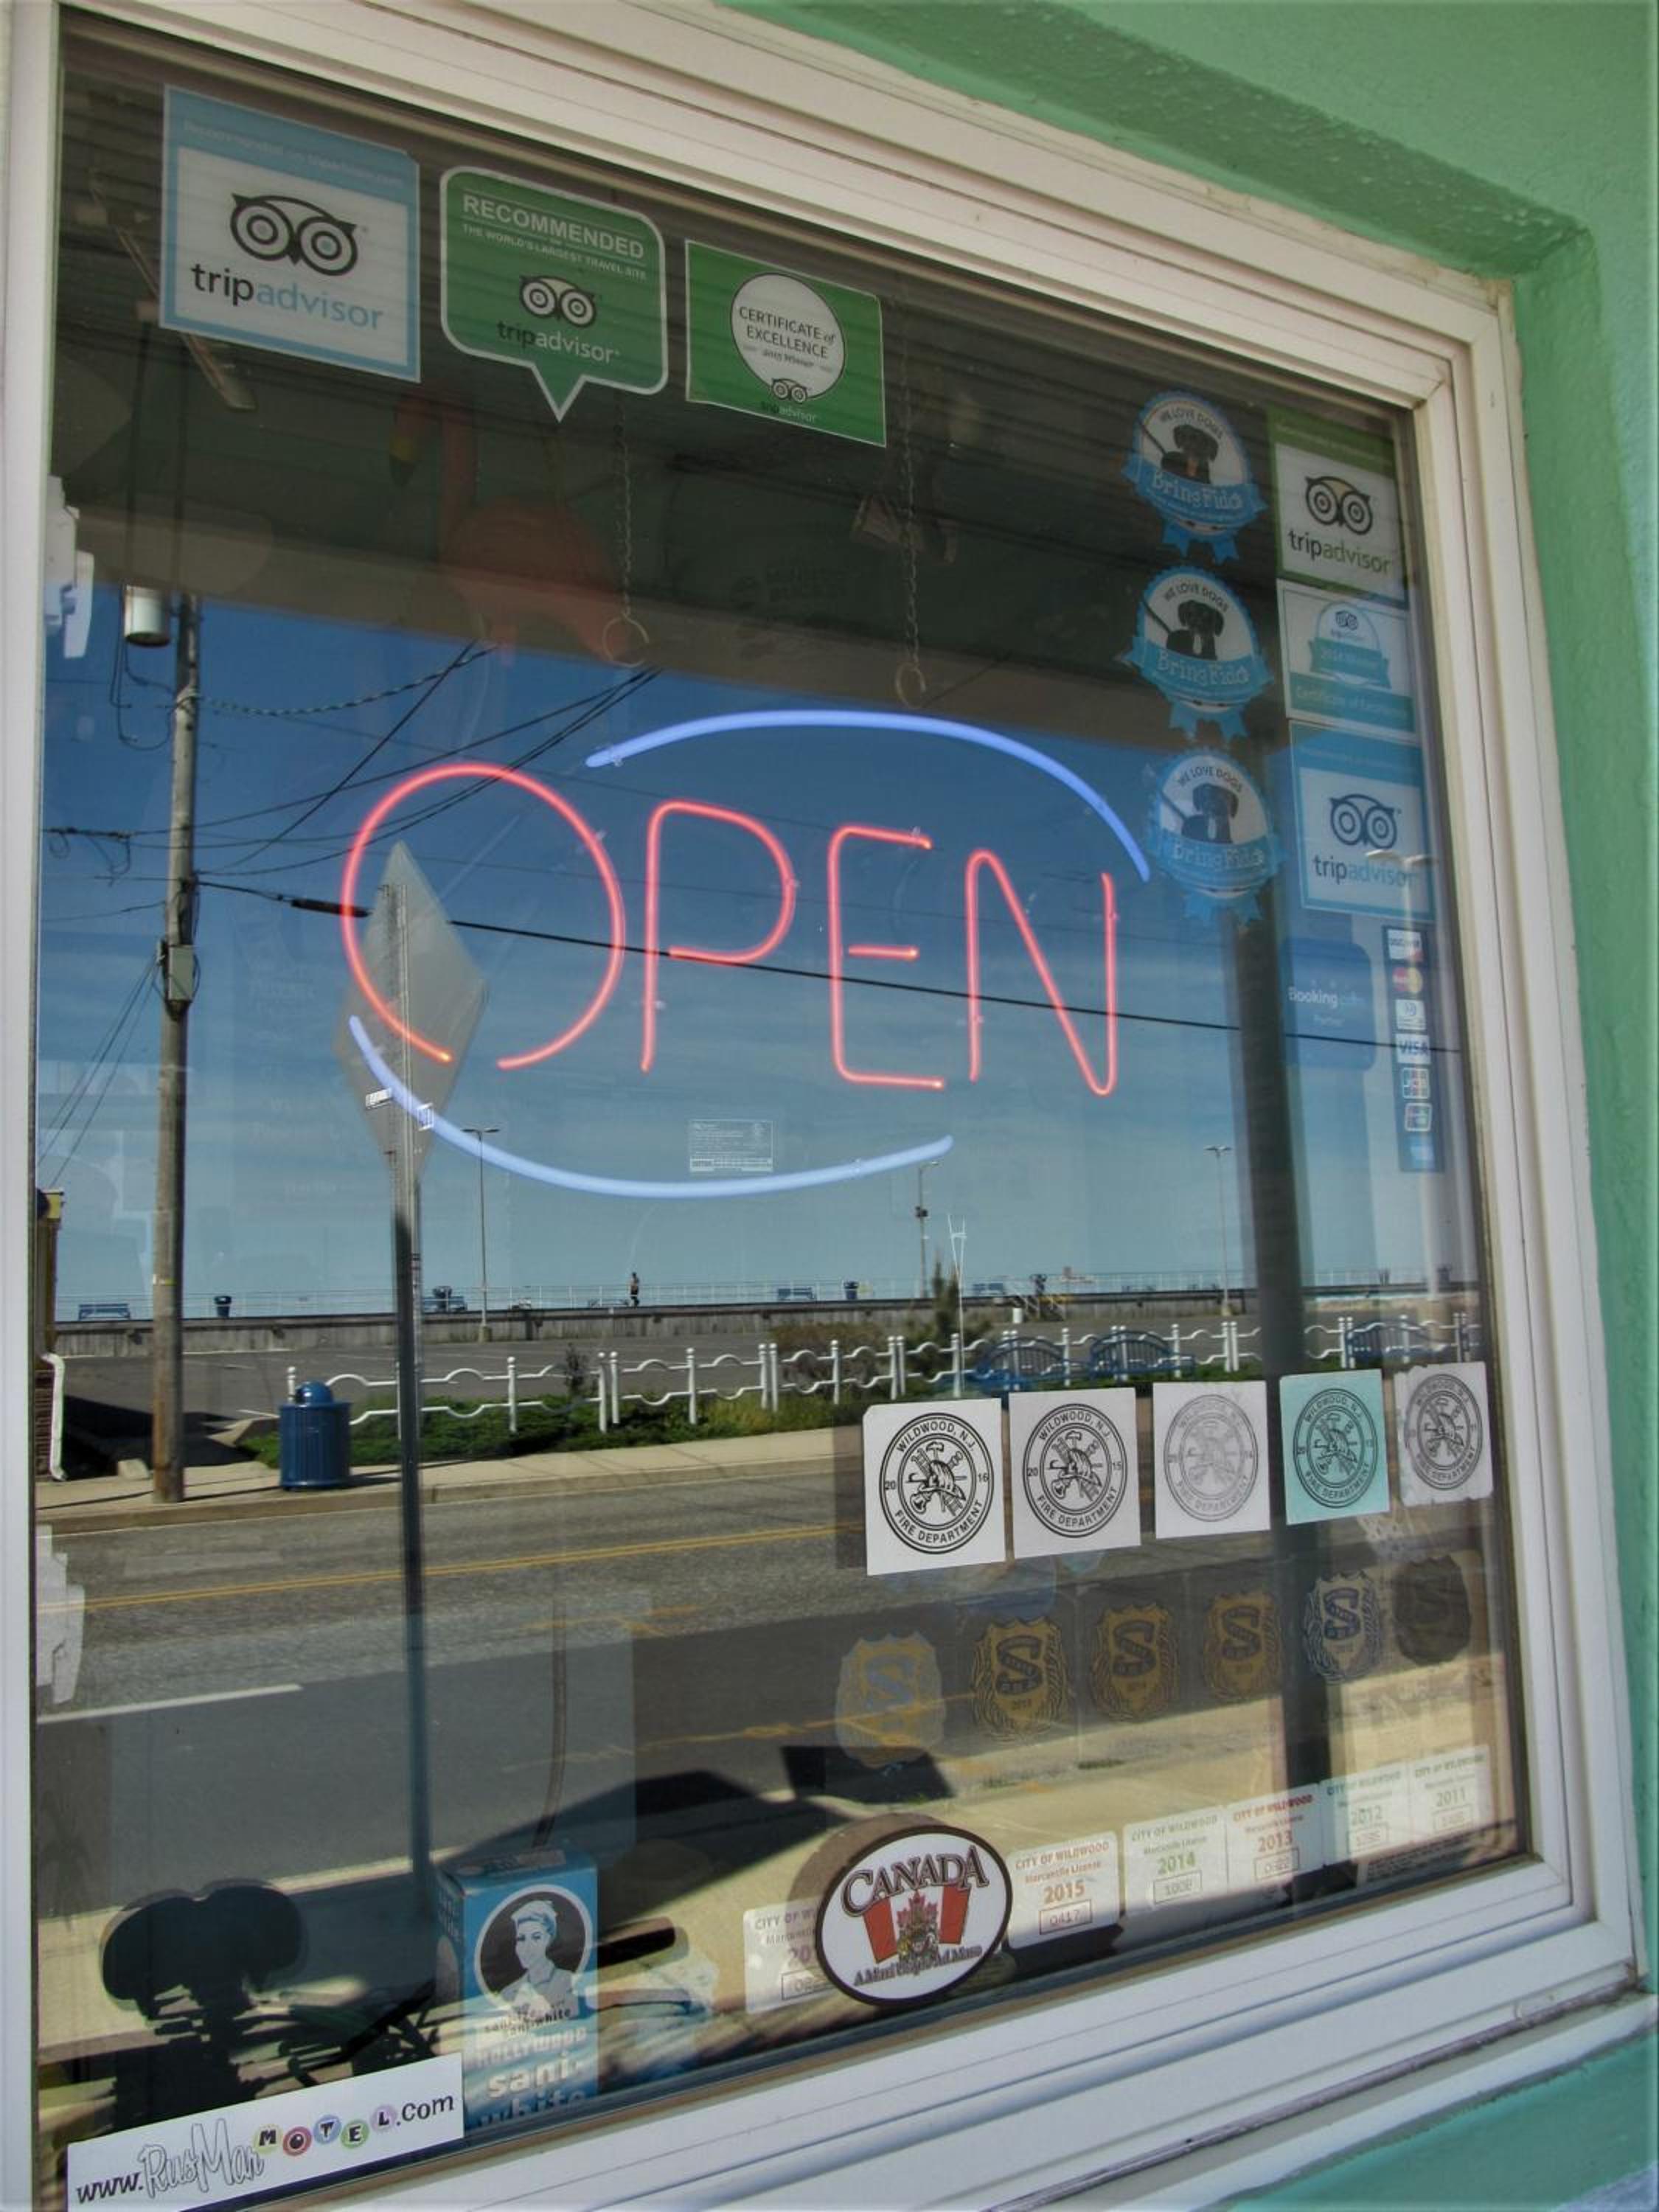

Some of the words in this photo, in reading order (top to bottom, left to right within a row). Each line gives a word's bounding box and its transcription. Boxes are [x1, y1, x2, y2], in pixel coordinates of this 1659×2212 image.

[462, 193, 645, 260] RECOMMENDED
[189, 262, 383, 332] tripadvisor
[739, 305, 821, 341] CERTIFICATE
[497, 319, 616, 365] tripadvisor
[746, 325, 828, 359] EXCELLENCE
[1287, 529, 1392, 575] tripadvisor
[1190, 765, 1214, 779] LOVE
[341, 762, 1117, 1096] OPEN
[1400, 1040, 1428, 1056] VISA
[895, 1420, 957, 1455] WILDWOOD,
[959, 1430, 975, 1453] N.J.
[1038, 1411, 1093, 1441] WILDWOOD,
[885, 1481, 897, 1492] 20
[977, 1472, 990, 1484] 16
[1027, 1467, 1039, 1478] 20
[1112, 1461, 1123, 1472] 15
[1323, 1462, 1371, 1499] DEPARTMENT
[894, 1509, 916, 1539] FIRE
[917, 1500, 983, 1544] DEPARTMENT
[1036, 1495, 1056, 1521] FIRE
[1057, 1484, 1120, 1528] DEPARTMENT
[1324, 1587, 1360, 1641] S
[1113, 1618, 1157, 1677] S
[1222, 1605, 1262, 1660] S
[995, 1634, 1043, 1695] S
[1436, 1787, 1467, 1806] 2011
[1350, 1805, 1383, 1826] 2012
[1131, 1828, 1153, 1842] CITY
[1257, 1829, 1293, 1853] 2013
[1015, 1857, 1040, 1871] CITY
[1040, 1852, 1054, 1865] OF
[1055, 1841, 1110, 1863] WILDWOOD
[1156, 1852, 1195, 1874] 2014
[841, 1844, 990, 1917] CANADA
[1043, 1879, 1085, 1903] 2015
[755, 1916, 781, 1930] CITY
